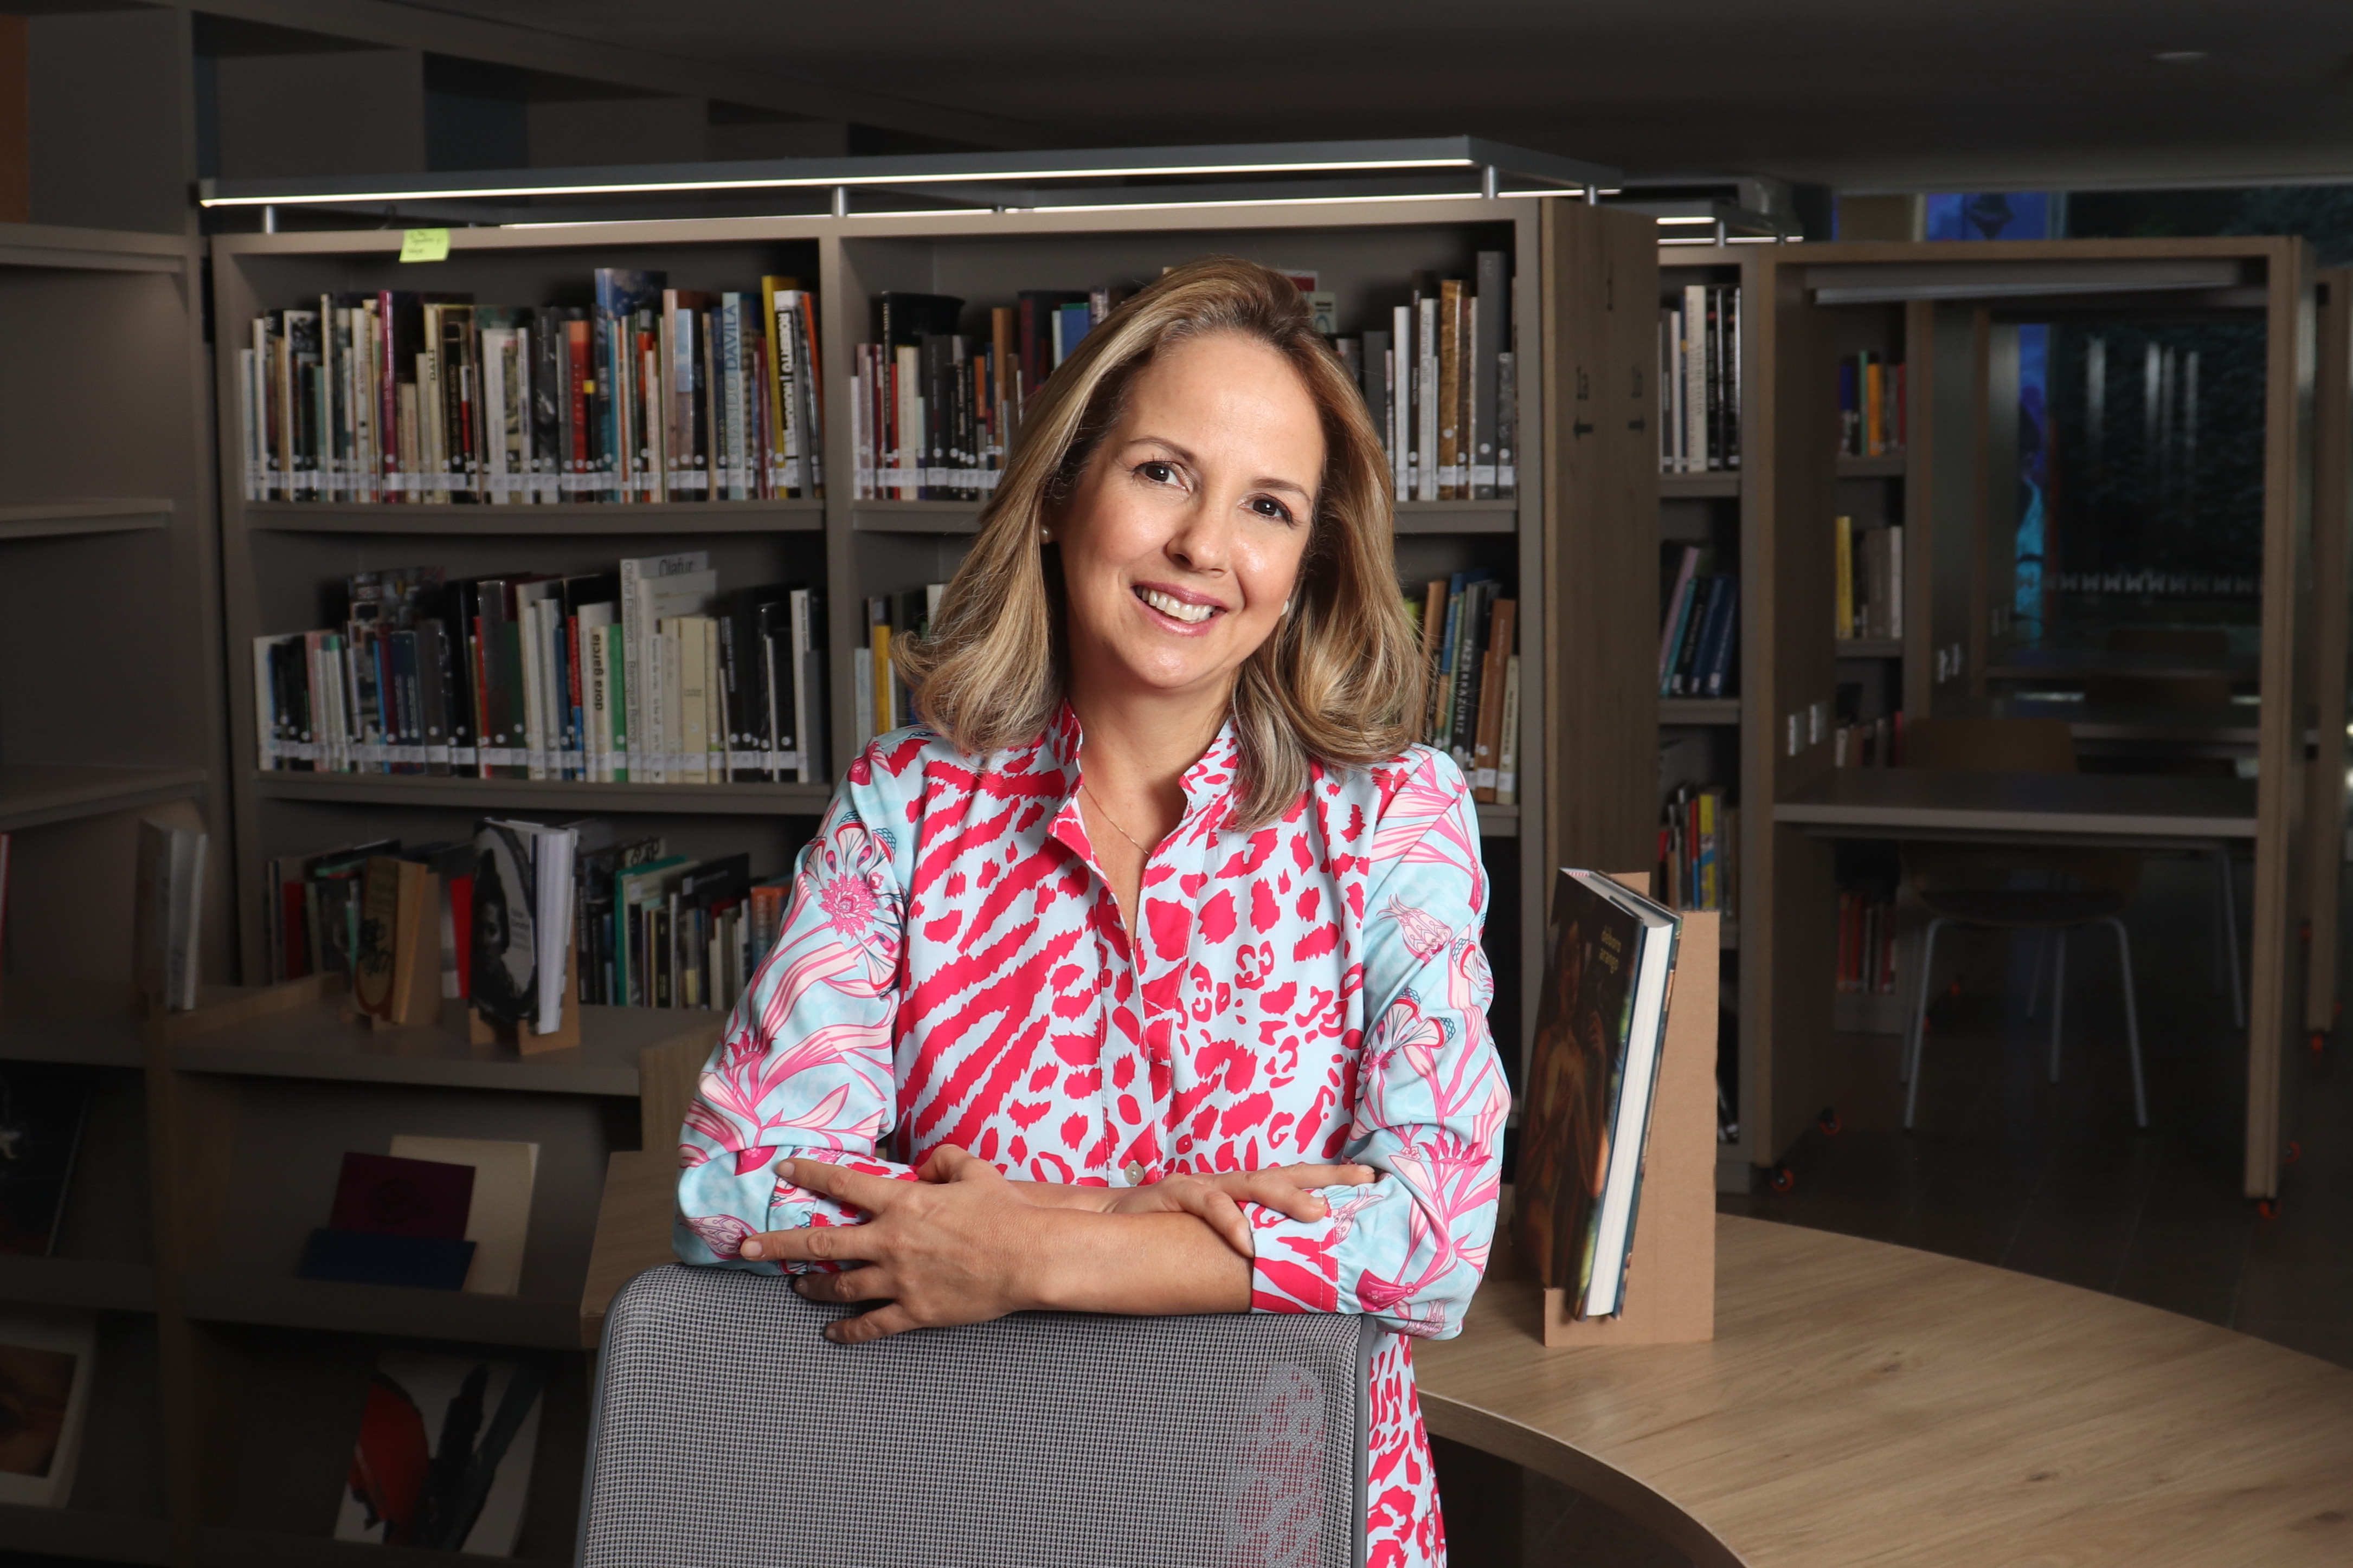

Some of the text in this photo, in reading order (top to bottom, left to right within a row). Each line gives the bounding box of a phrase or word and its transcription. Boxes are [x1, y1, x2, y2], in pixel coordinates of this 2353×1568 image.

[777, 312, 792, 373] ROBERTO
[623, 562, 633, 595] Olafur
[624, 598, 634, 642] Eliasson
[594, 680, 603, 711] dora
